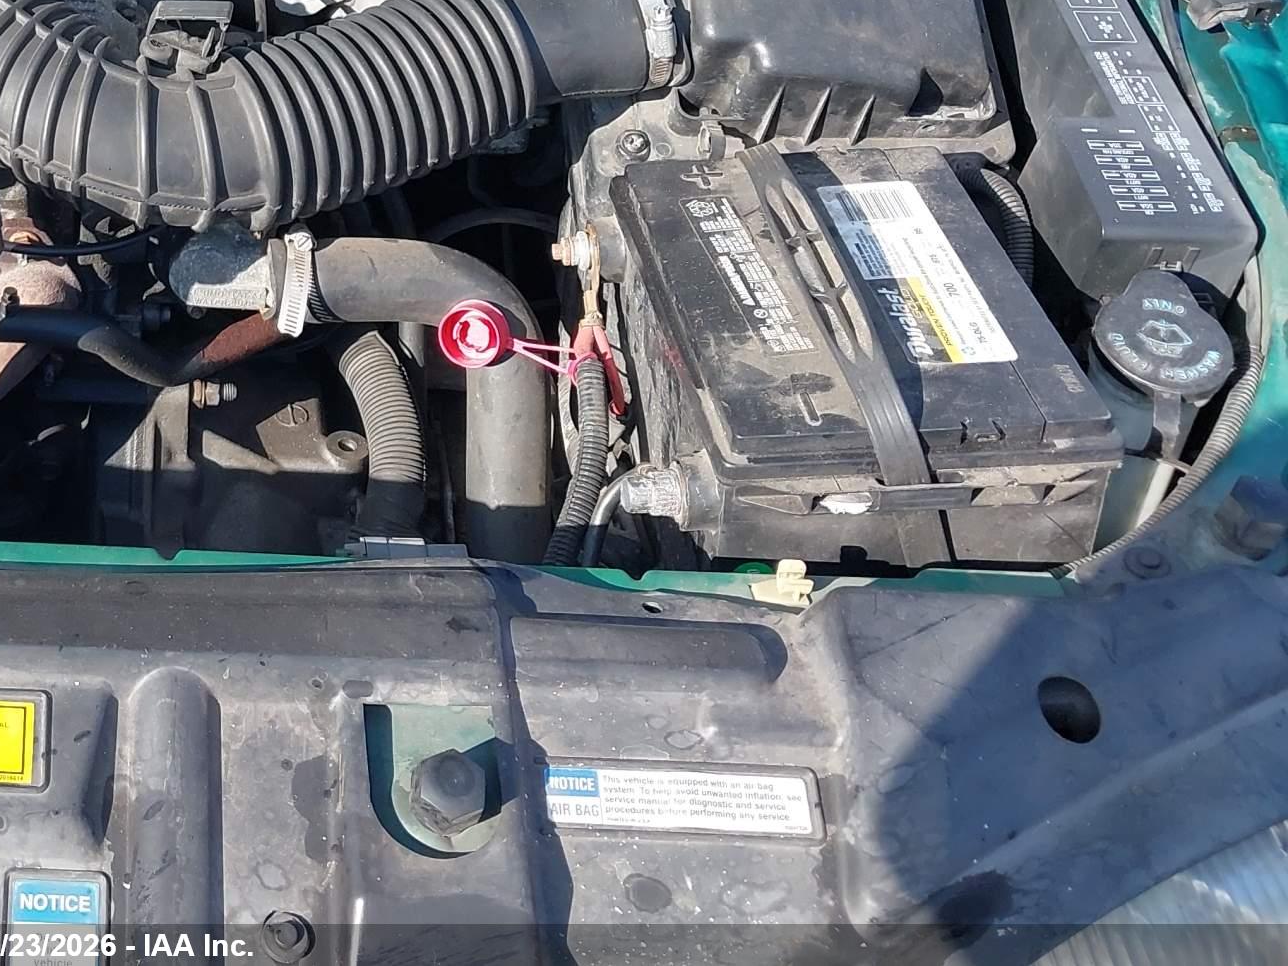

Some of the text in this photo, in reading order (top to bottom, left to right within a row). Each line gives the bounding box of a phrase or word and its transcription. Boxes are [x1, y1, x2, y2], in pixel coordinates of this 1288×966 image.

[878, 287, 934, 358] Duralast
[549, 776, 596, 791] NOTICE
[624, 776, 655, 785] vehicle
[667, 777, 708, 788] equipped
[710, 779, 728, 788] with
[757, 782, 774, 792] bag
[675, 788, 743, 799] avoid unwanted
[549, 802, 600, 817] AIR BAG
[604, 796, 787, 811] service diagnostic and service
[605, 805, 755, 821] procedures performing any
[19, 893, 91, 912] NOTICE
